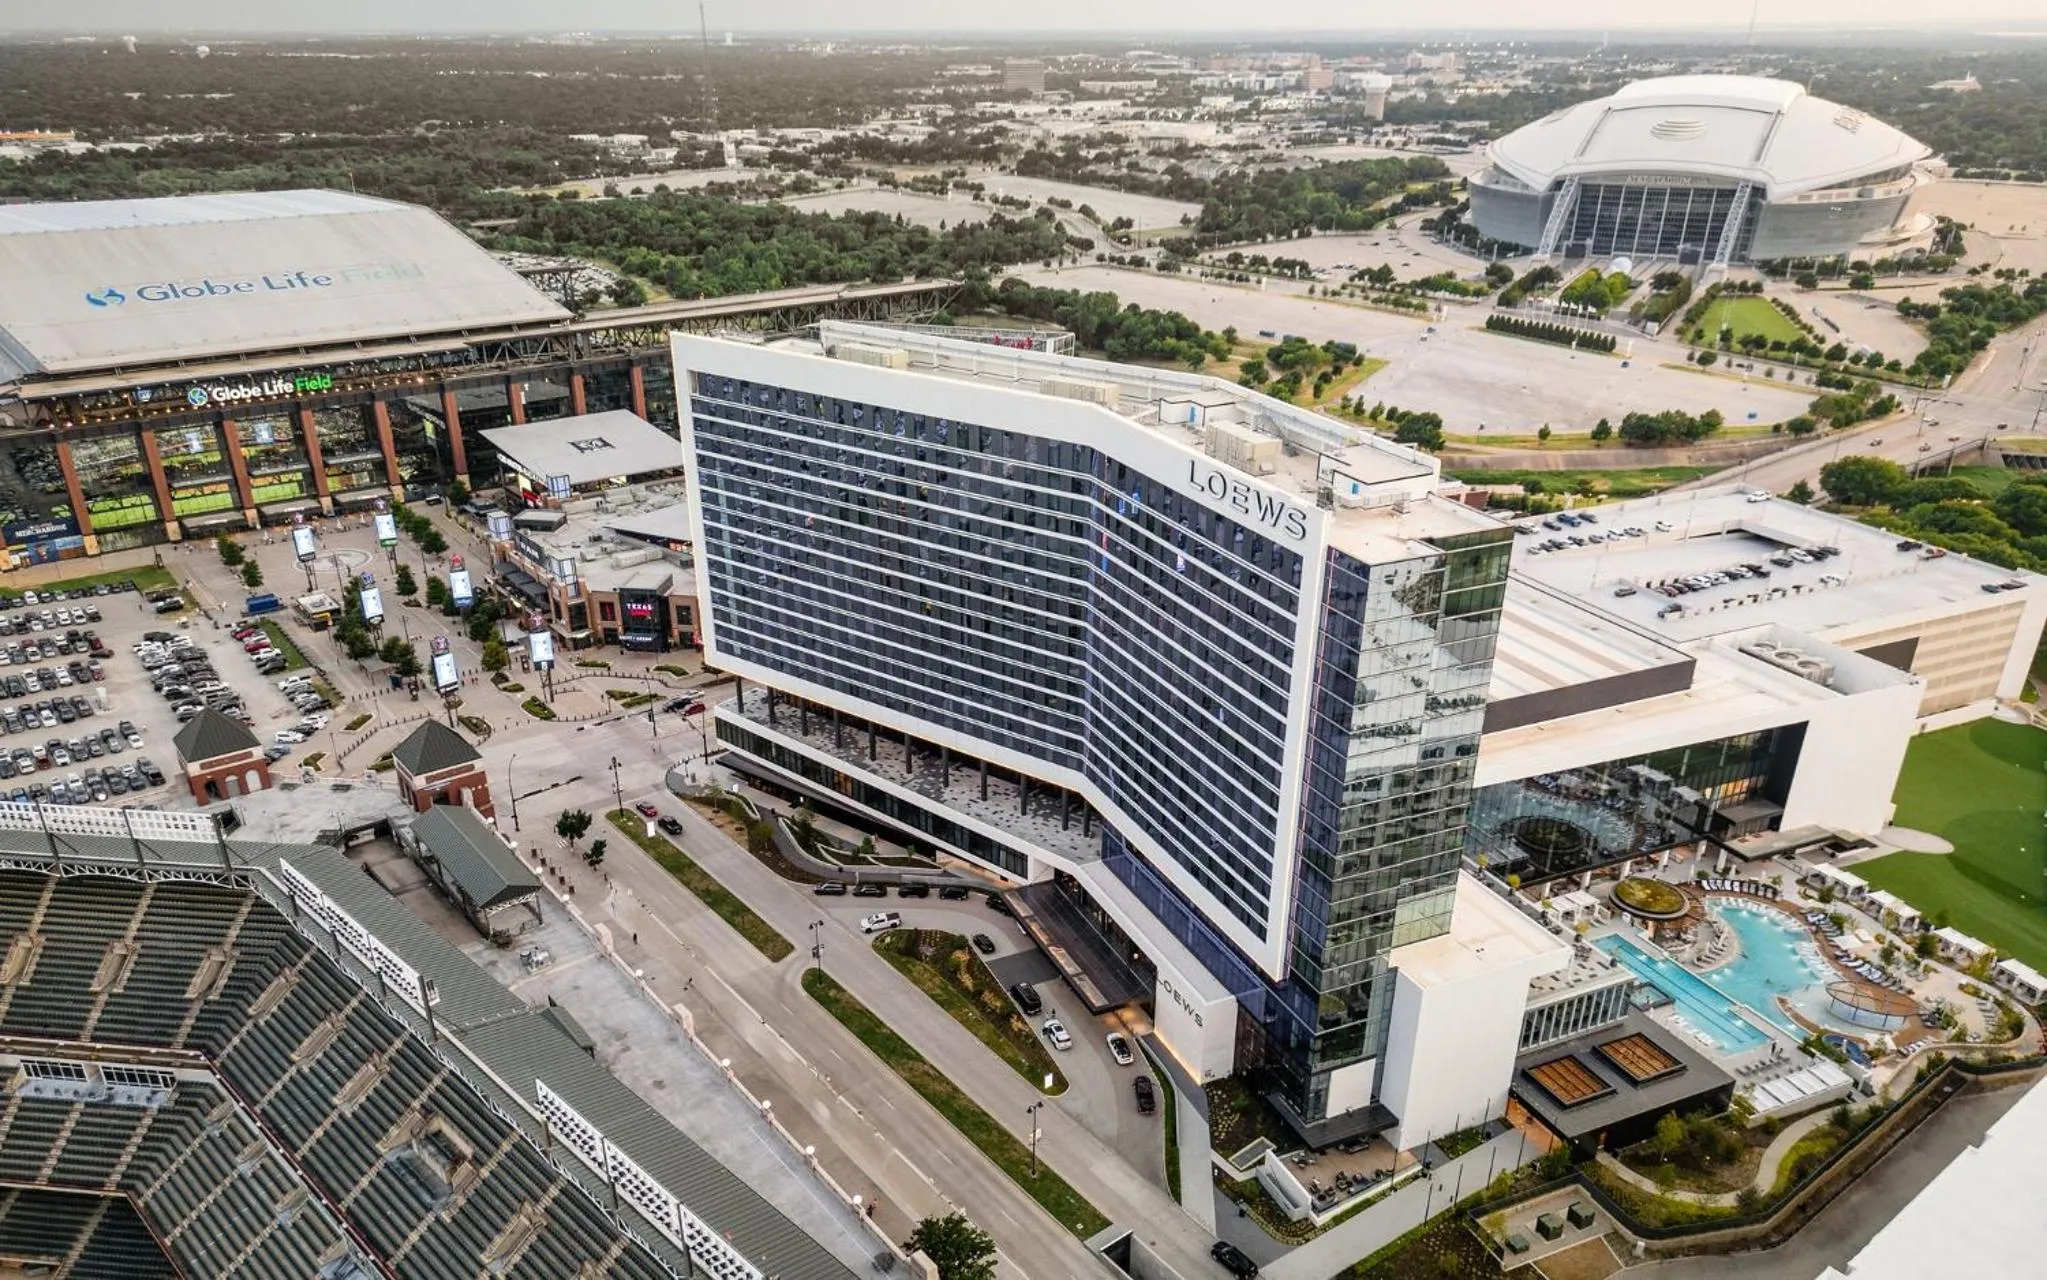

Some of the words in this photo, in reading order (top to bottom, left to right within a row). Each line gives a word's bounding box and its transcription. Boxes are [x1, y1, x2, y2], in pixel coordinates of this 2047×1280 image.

[1651, 175, 1692, 185] STADIUM
[136, 279, 255, 302] Globe
[262, 270, 333, 291] Life
[340, 262, 426, 284] Field
[212, 384, 262, 402] Globe
[264, 379, 294, 397] Life
[295, 374, 333, 392] Field
[1189, 459, 1308, 541] LOEWS
[626, 602, 652, 611] TEXAS
